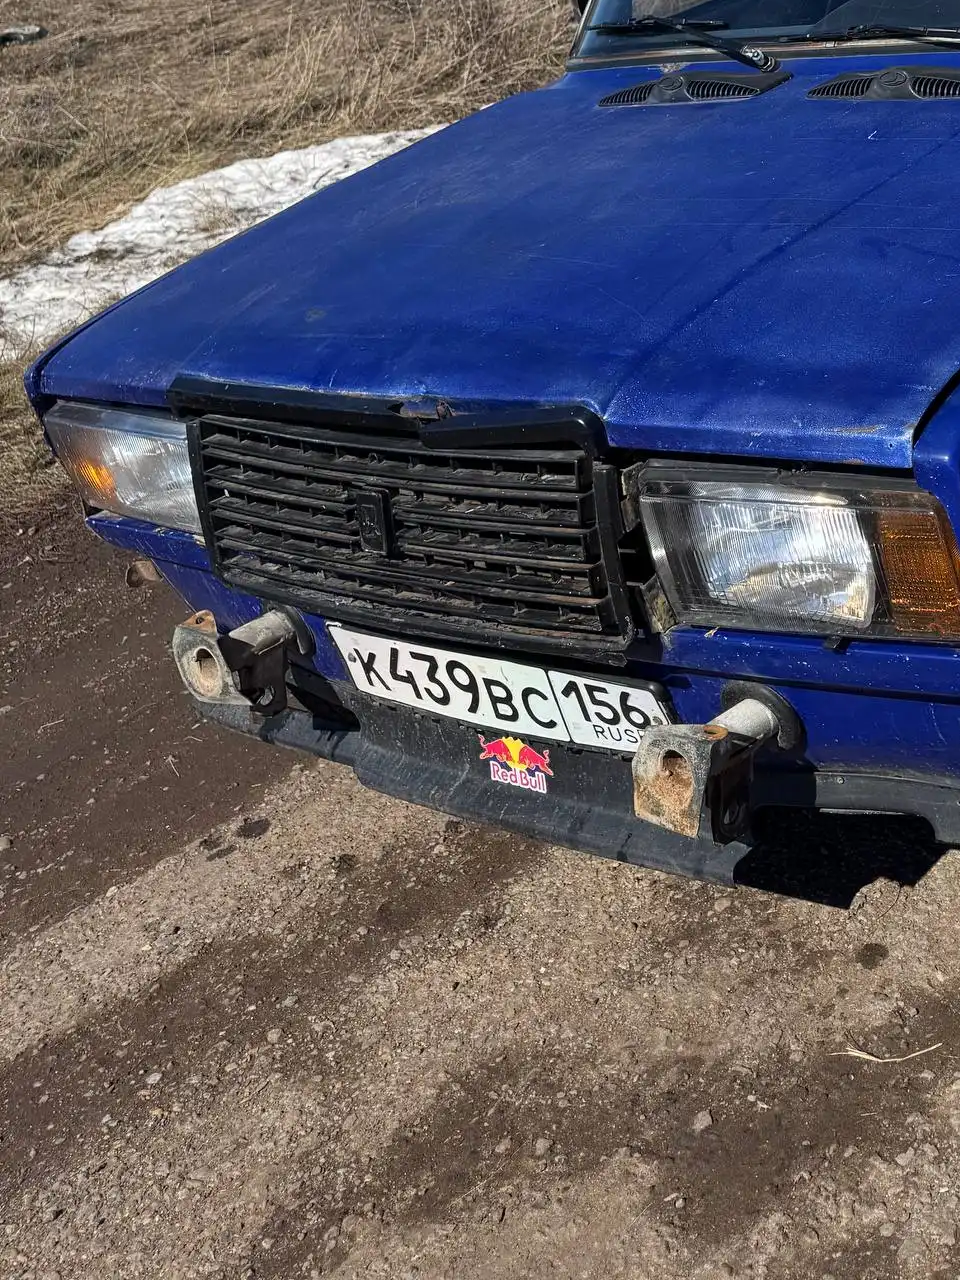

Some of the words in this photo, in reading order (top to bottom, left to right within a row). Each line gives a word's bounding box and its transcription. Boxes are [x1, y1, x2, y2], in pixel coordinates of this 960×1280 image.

[561, 680, 652, 730] 156
[592, 724, 639, 744] RUS
[491, 762, 518, 784] Red
[519, 769, 547, 792] Bull
